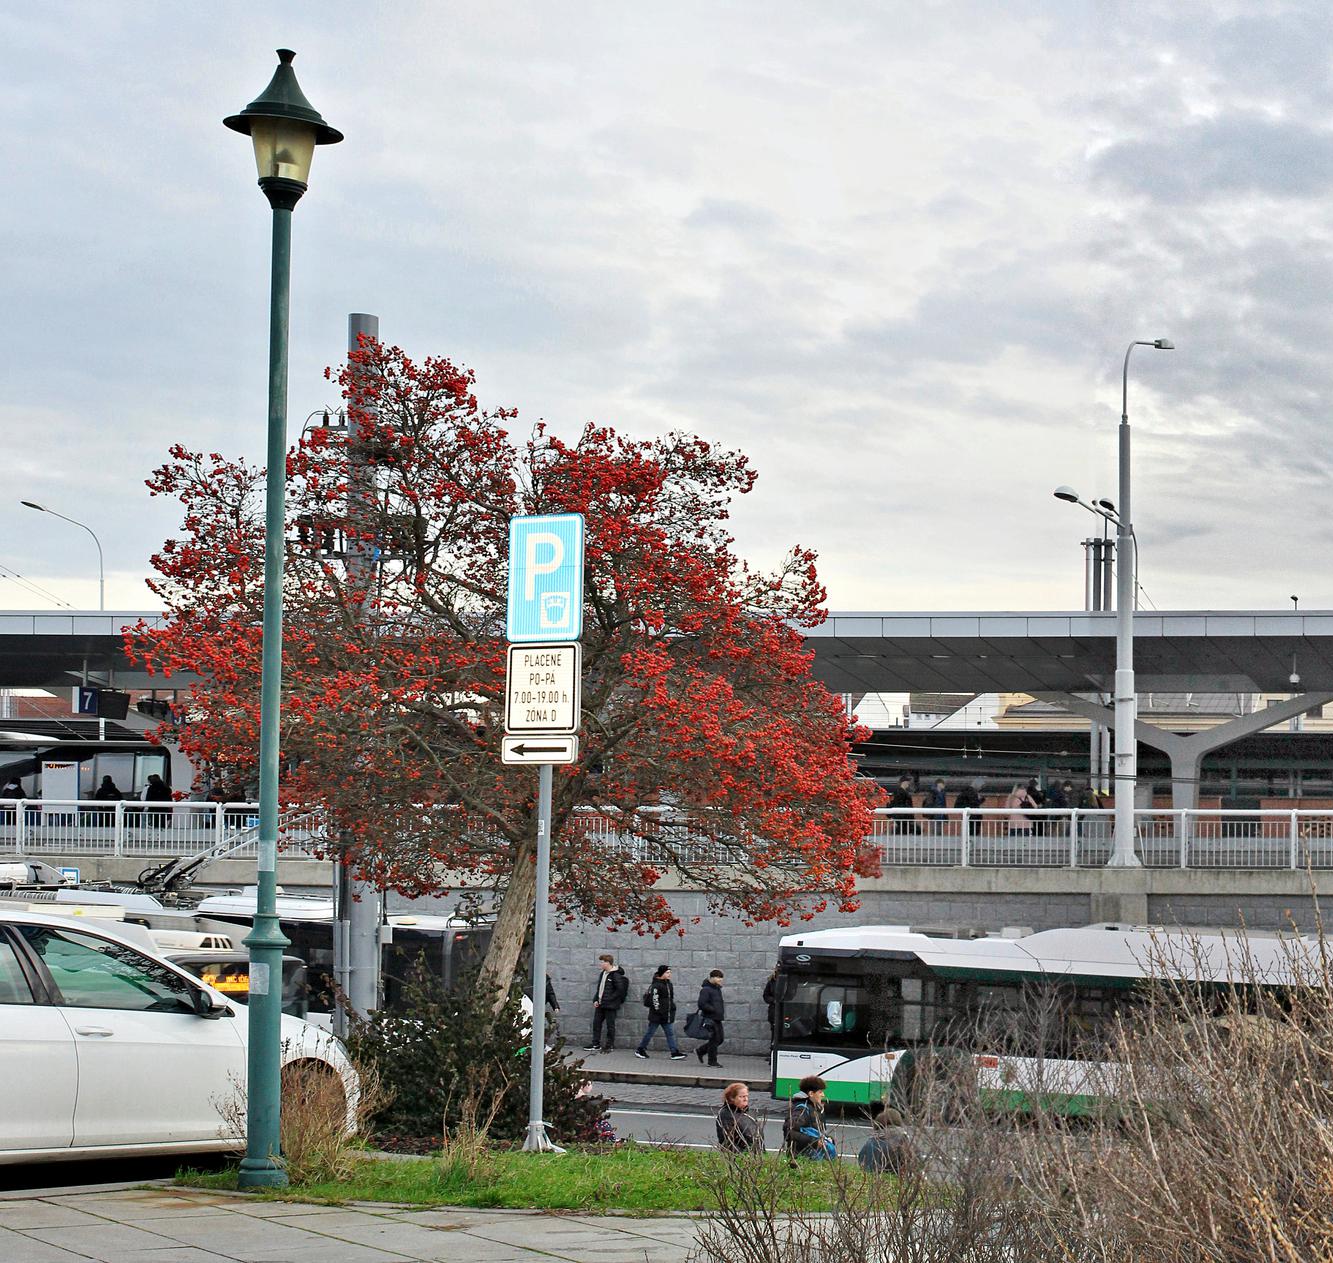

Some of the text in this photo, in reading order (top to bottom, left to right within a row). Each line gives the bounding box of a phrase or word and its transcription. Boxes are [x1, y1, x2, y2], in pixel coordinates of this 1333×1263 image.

[524, 532, 565, 601] P
[524, 651, 562, 668] PLACENÉ
[529, 670, 556, 685] PO-PÁ
[82, 691, 92, 711] 7
[514, 691, 559, 704] 7.00-19.00
[525, 706, 557, 722] ZÓNA D
